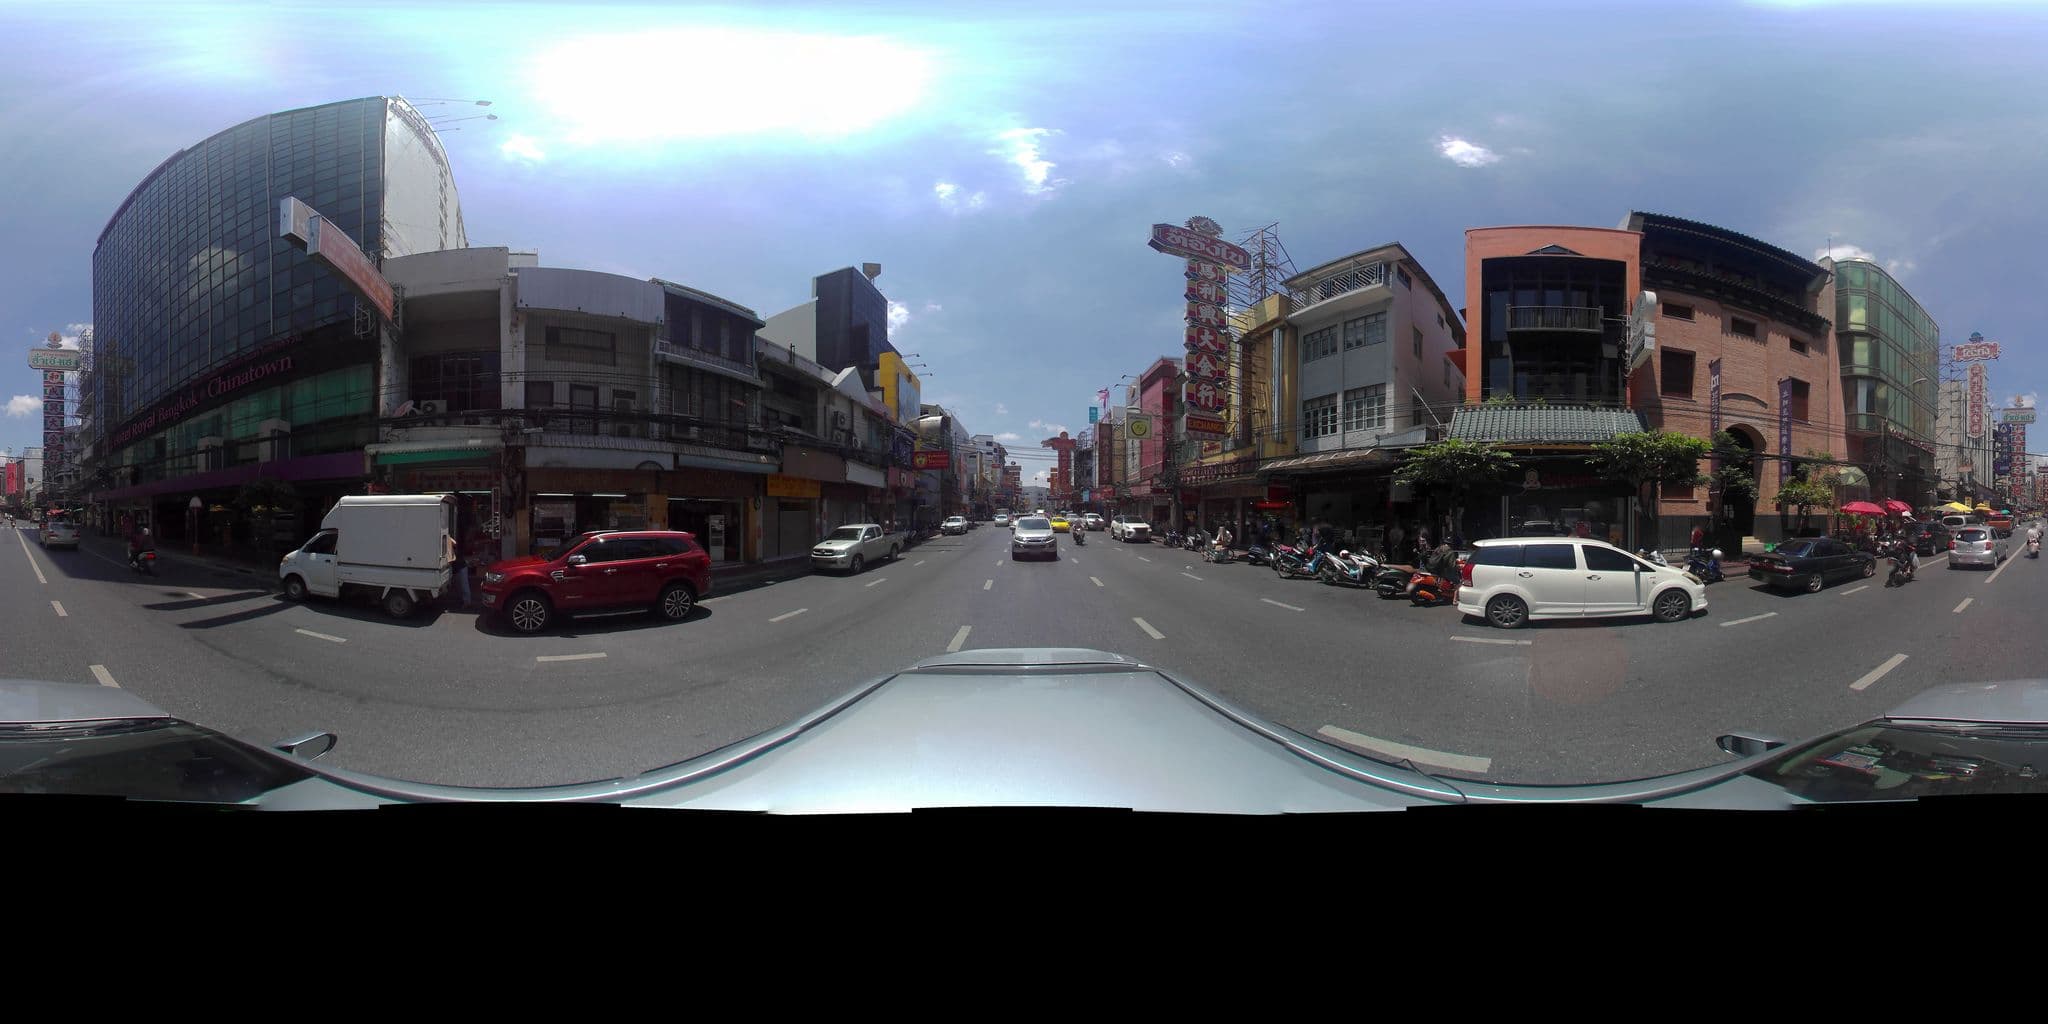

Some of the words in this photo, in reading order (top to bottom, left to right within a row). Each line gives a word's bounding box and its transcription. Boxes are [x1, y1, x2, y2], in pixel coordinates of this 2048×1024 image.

[132, 411, 155, 440] Royal
[158, 392, 199, 422] Bangkok
[207, 354, 293, 398] Chinatown
[1188, 419, 1225, 433] EXCHANGE
